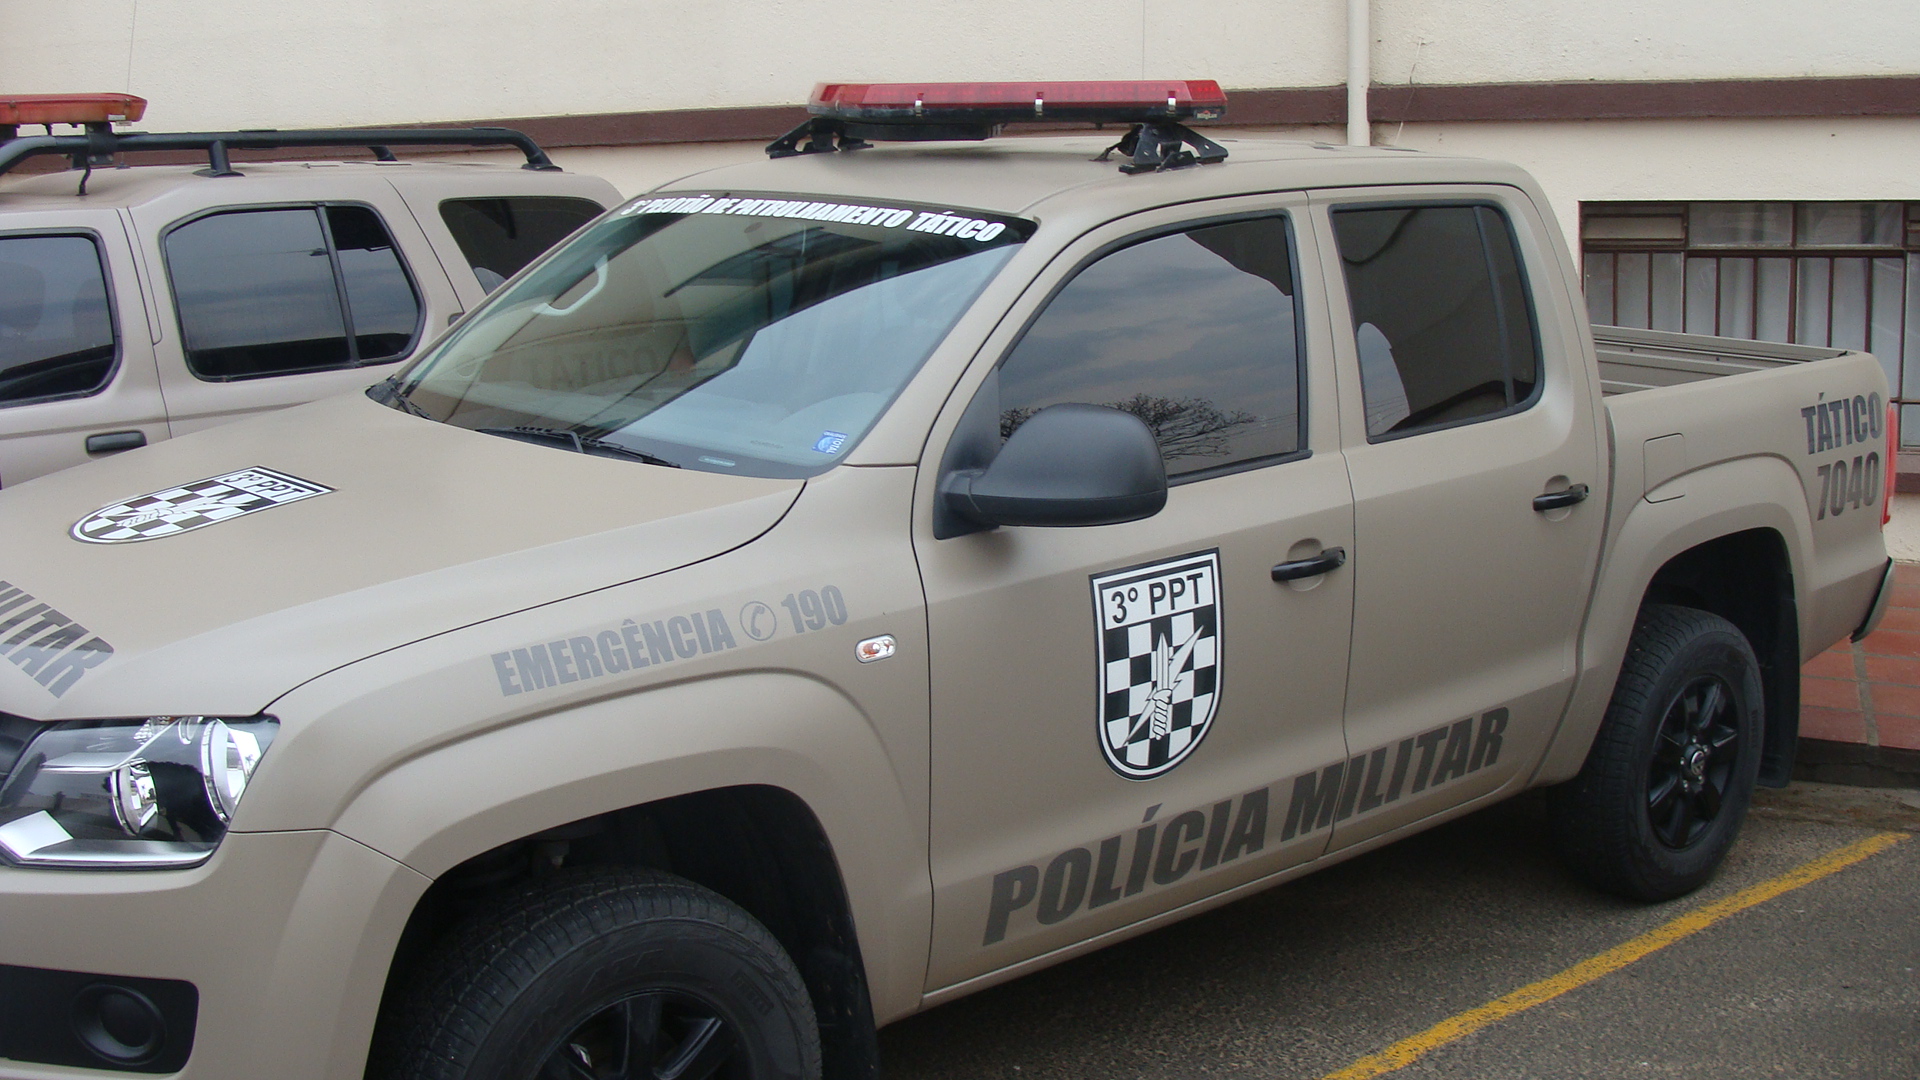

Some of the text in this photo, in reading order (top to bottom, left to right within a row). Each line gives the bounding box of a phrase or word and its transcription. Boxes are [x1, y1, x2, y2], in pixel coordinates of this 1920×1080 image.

[701, 199, 741, 214] DE
[726, 199, 914, 228] PATRULHAMENTO
[906, 211, 1006, 242] TÁTICO
[1801, 392, 1882, 455] TÁTICO
[243, 480, 306, 499] PPT
[1817, 452, 1879, 521] 7040
[1149, 573, 1203, 615] PPT
[491, 585, 848, 697] EMERGÊNCIA 190
[982, 706, 1509, 947] POLÍCIA MILITAR
